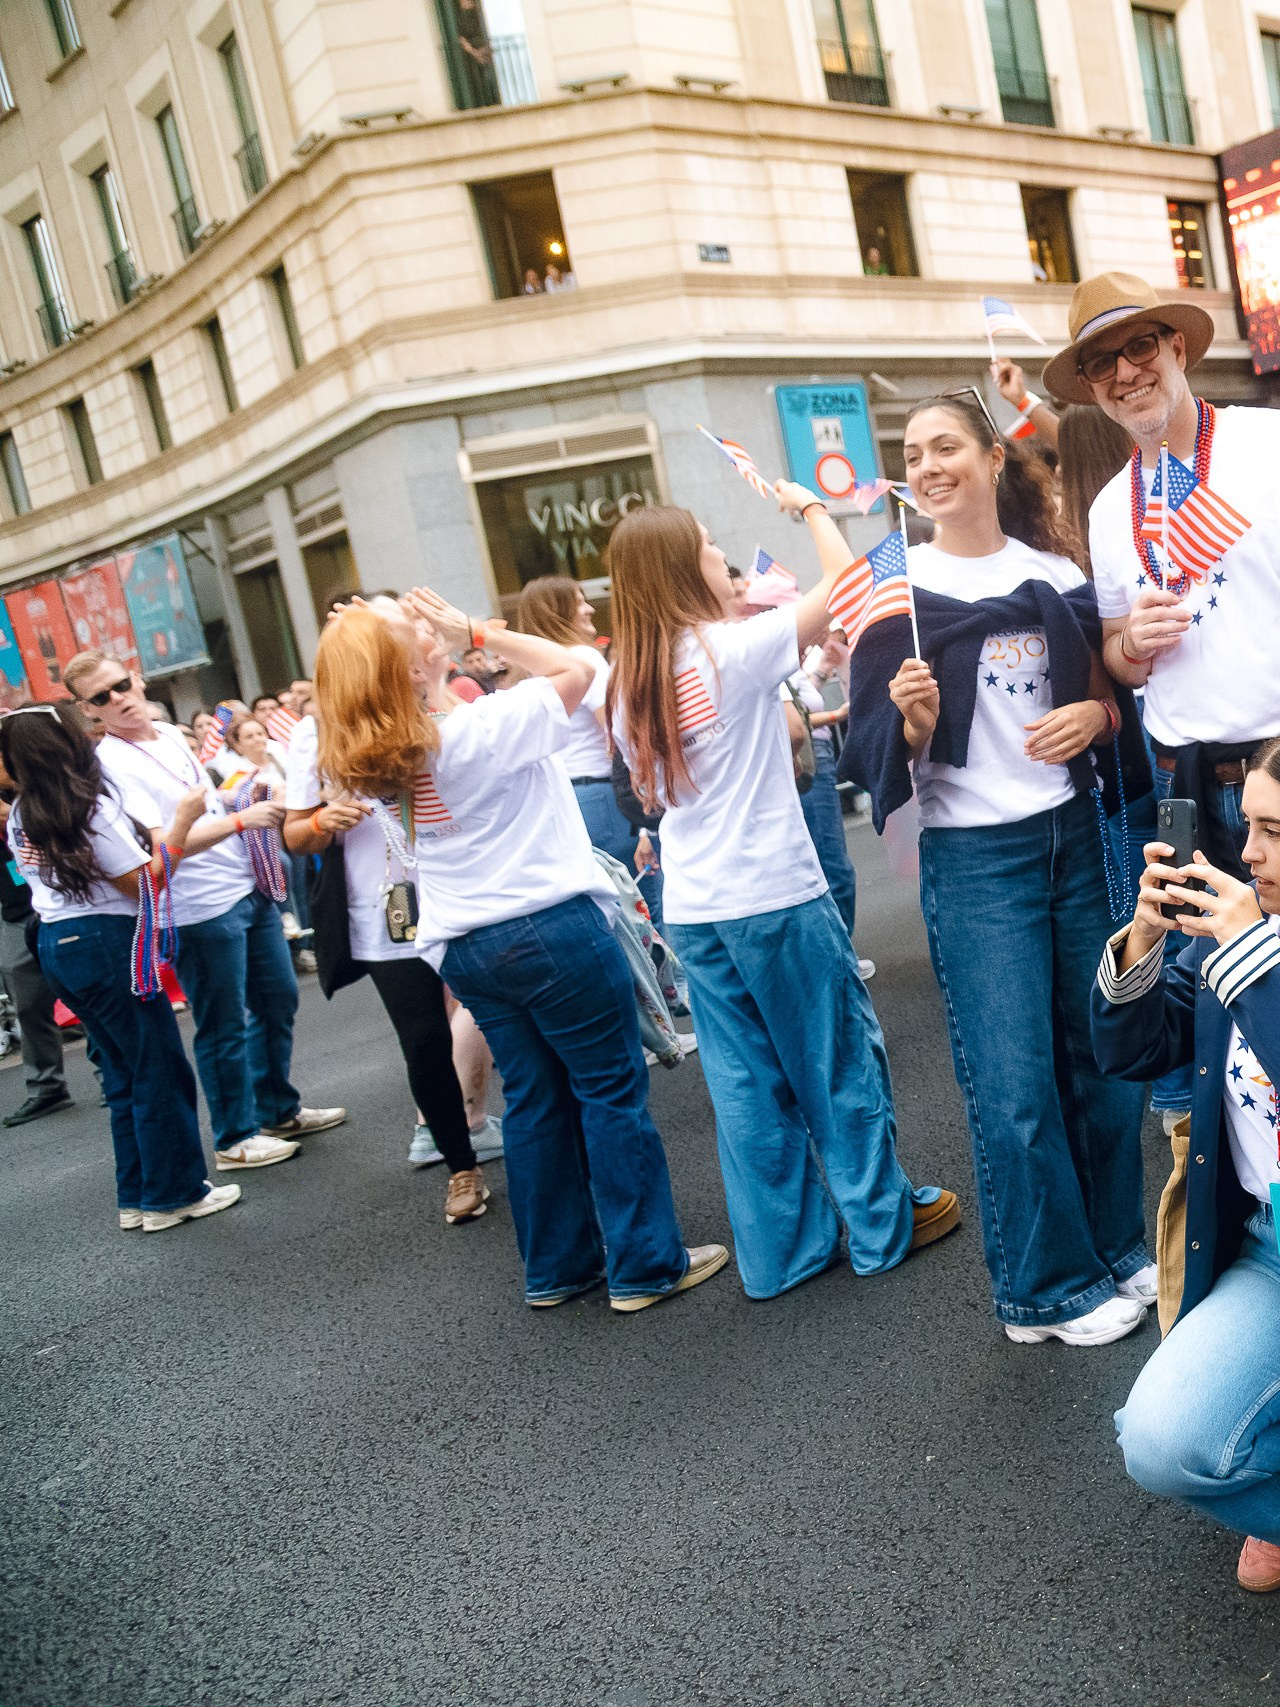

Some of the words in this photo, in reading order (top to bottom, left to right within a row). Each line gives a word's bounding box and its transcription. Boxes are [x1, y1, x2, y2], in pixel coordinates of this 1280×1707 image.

[811, 391, 859, 407] ZONA
[551, 536, 599, 560] VIA
[987, 636, 1046, 669] 250
